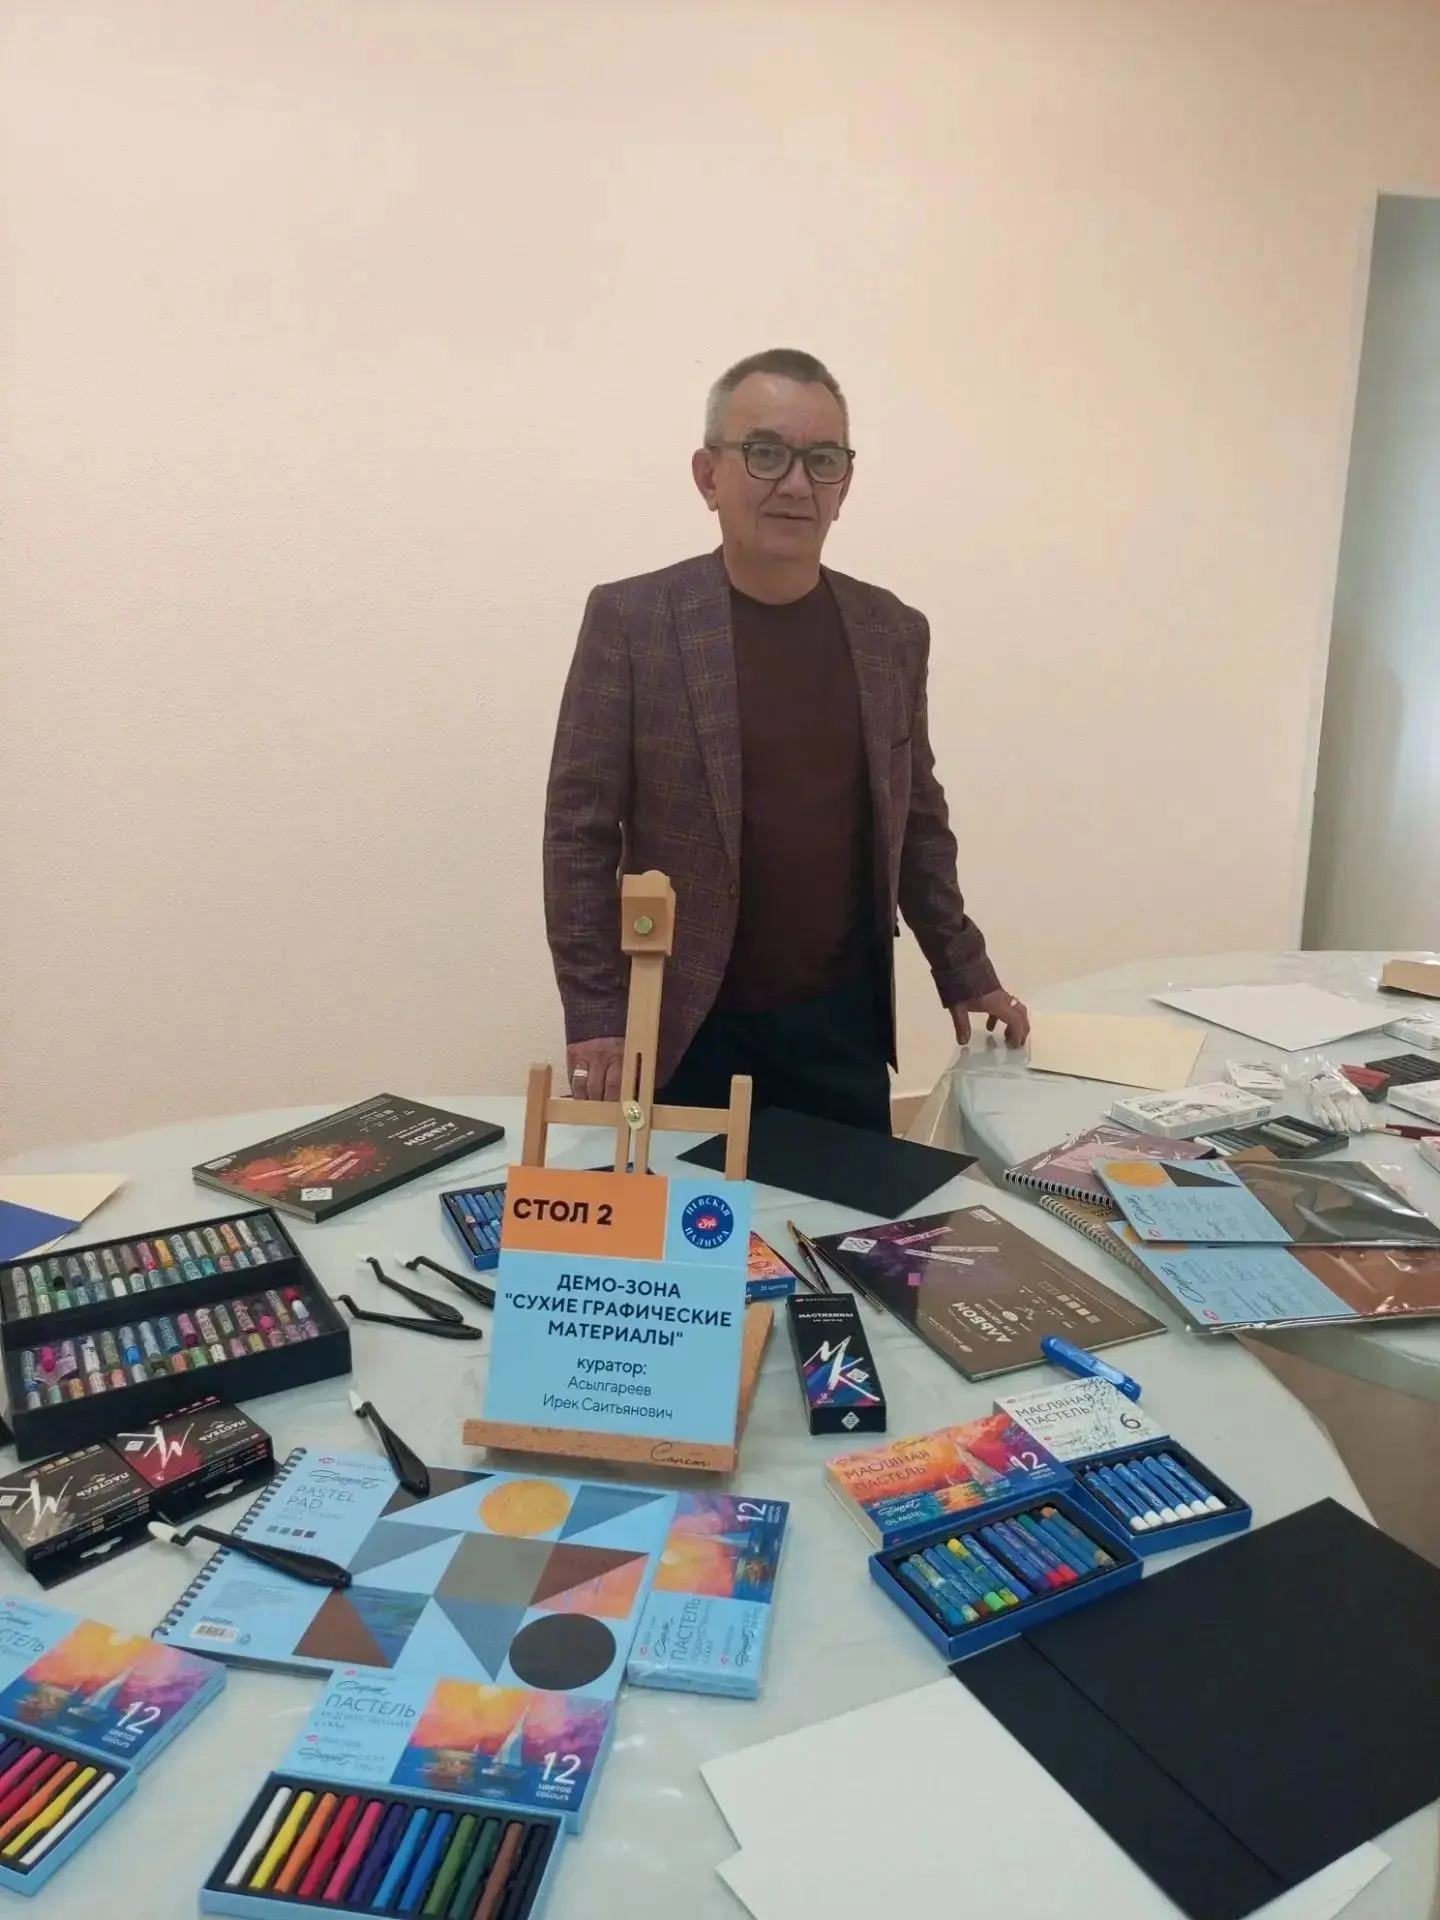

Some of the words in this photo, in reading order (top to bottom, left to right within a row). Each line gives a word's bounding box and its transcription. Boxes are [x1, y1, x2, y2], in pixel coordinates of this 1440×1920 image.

[513, 1198, 588, 1224] СТОЛ
[597, 1204, 613, 1226] 2
[556, 1273, 681, 1299] ДЕМО-ЗОНА
[505, 1292, 577, 1313] "СУХИЕ
[582, 1299, 732, 1328] ГРАФИЧЕСКИЕ
[548, 1319, 683, 1347] МАТЕРИАЛЫ"
[577, 1357, 648, 1376] куратор:
[568, 1375, 652, 1397] Асылгареев
[543, 1393, 579, 1413] Ирек
[582, 1396, 673, 1420] Саитьянович
[1015, 1393, 1094, 1417] МАСЛЯНАЯ
[1024, 1406, 1091, 1427] ПАСТЕЛЬ
[1120, 1412, 1141, 1430] 6
[844, 1450, 930, 1479] МАСЛЯНАЯ
[1009, 1451, 1048, 1472] 12
[854, 1466, 926, 1491] ПАСТЕЛЬ
[286, 1496, 323, 1509] PAD
[295, 1484, 356, 1502] PASTEL
[736, 1502, 767, 1522] 12
[670, 1597, 700, 1660] ПАСТЕЛЬ
[117, 1701, 161, 1734] 12
[325, 1693, 416, 1718] ПАСТЕЛЬ
[541, 1751, 581, 1785] 12
